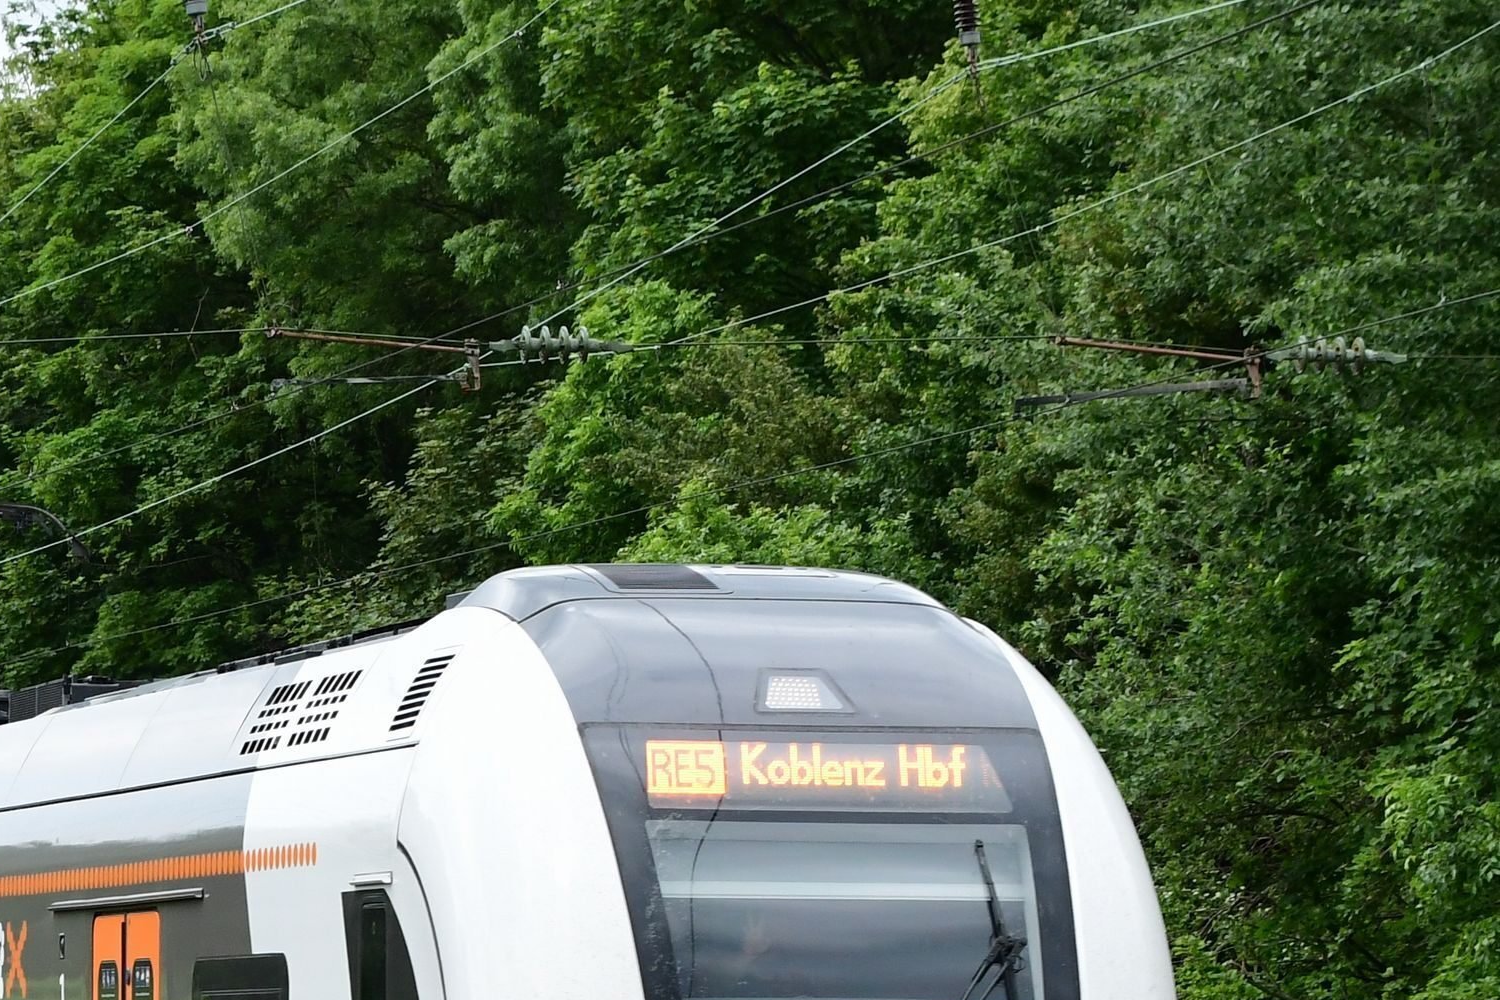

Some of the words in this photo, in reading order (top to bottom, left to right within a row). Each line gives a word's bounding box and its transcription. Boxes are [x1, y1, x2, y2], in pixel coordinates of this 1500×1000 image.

[651, 747, 718, 789] RE5
[740, 742, 887, 787] Koblenz
[899, 744, 966, 788] Hbf
